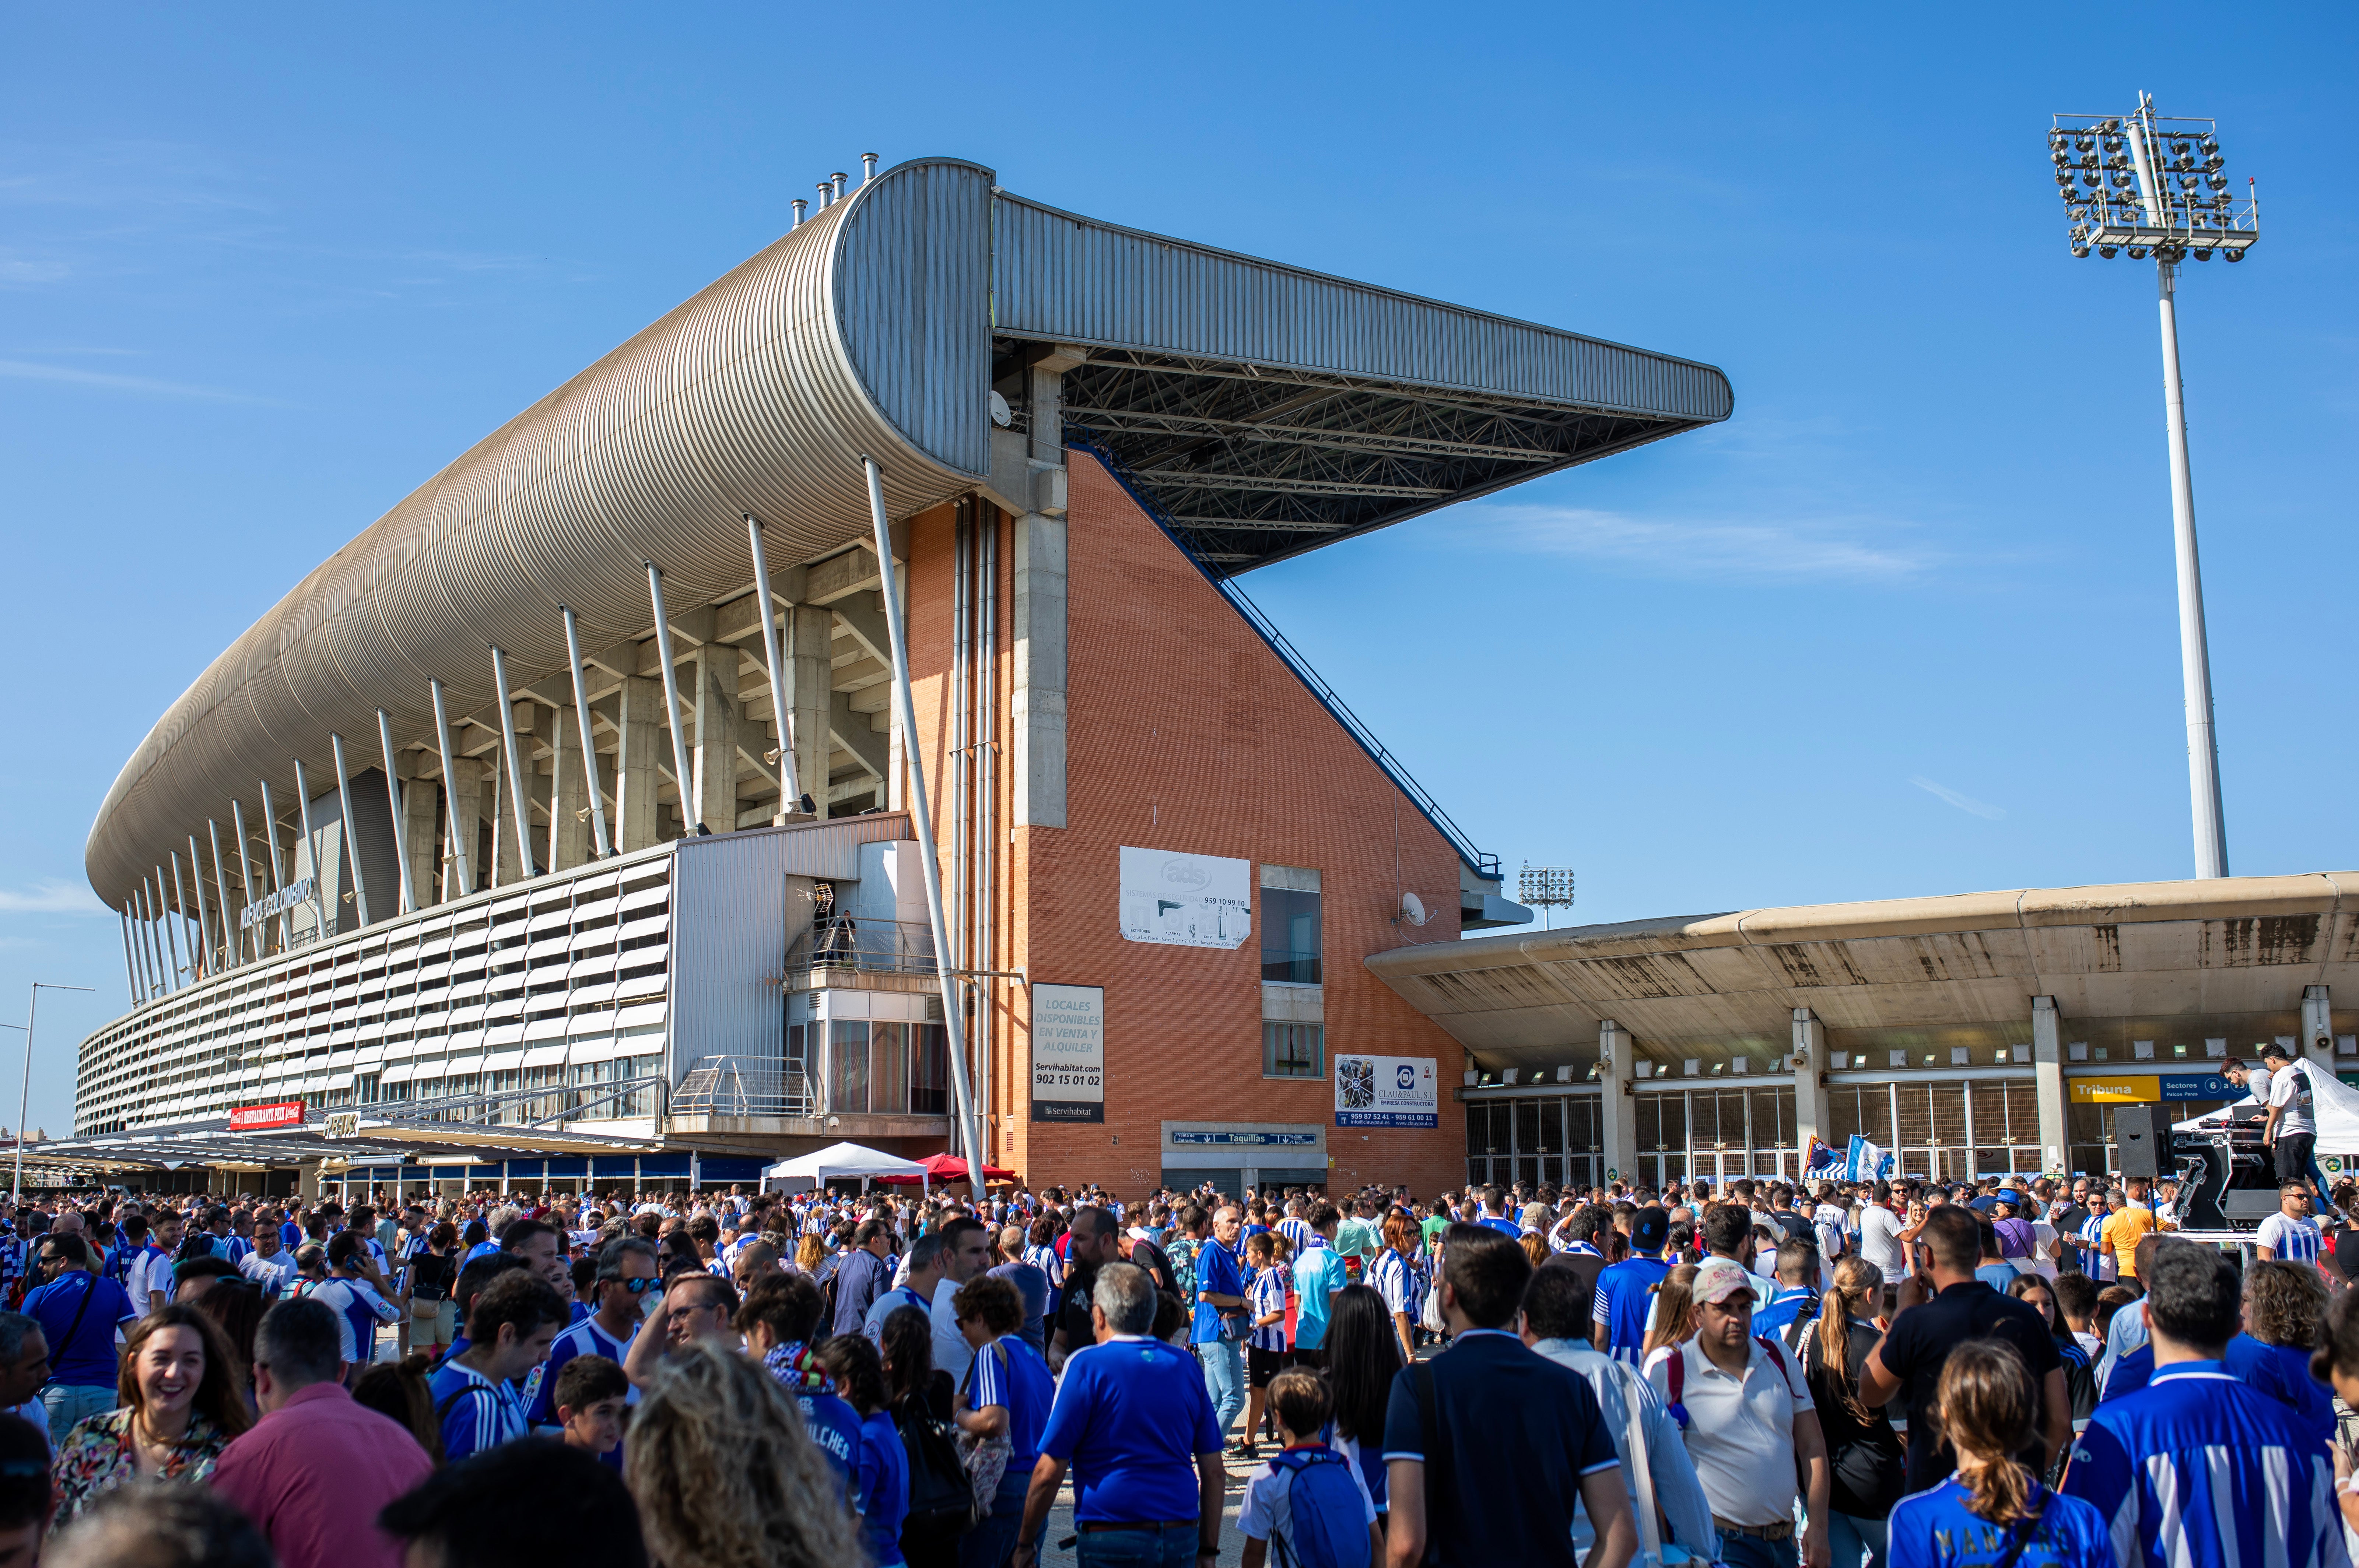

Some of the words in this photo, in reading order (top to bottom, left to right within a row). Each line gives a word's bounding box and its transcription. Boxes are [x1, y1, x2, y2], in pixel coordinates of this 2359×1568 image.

[1167, 862, 1205, 885] ads
[1126, 889, 1156, 899] SISTEMAS
[1168, 893, 1203, 903] SEGURIDAD
[240, 899, 262, 930] NUEVO
[266, 876, 311, 918] COLOMBINO
[1046, 999, 1090, 1011] LOCALES
[1035, 1013, 1100, 1026] DISPONIBLES
[1038, 1027, 1053, 1037] EN
[1056, 1028, 1088, 1039] VENTA
[1091, 1030, 1098, 1039] Y
[1043, 1041, 1093, 1053] ALQUILER
[1035, 1062, 1100, 1073] Servihabitat.com
[1036, 1074, 1055, 1084] 902
[1058, 1075, 1070, 1085] 15
[1073, 1075, 1084, 1085] 01
[1088, 1076, 1100, 1086] 02
[1378, 1090, 1422, 1099] CLAU&PAUL,
[2077, 1084, 2132, 1095] Tribuna
[243, 1108, 274, 1124] RESTAURANTE
[274, 1106, 285, 1121] PEIX
[1053, 1107, 1091, 1116] Servihabitat
[323, 1114, 357, 1137] PEIX
[1229, 1134, 1265, 1143] Taquillas
